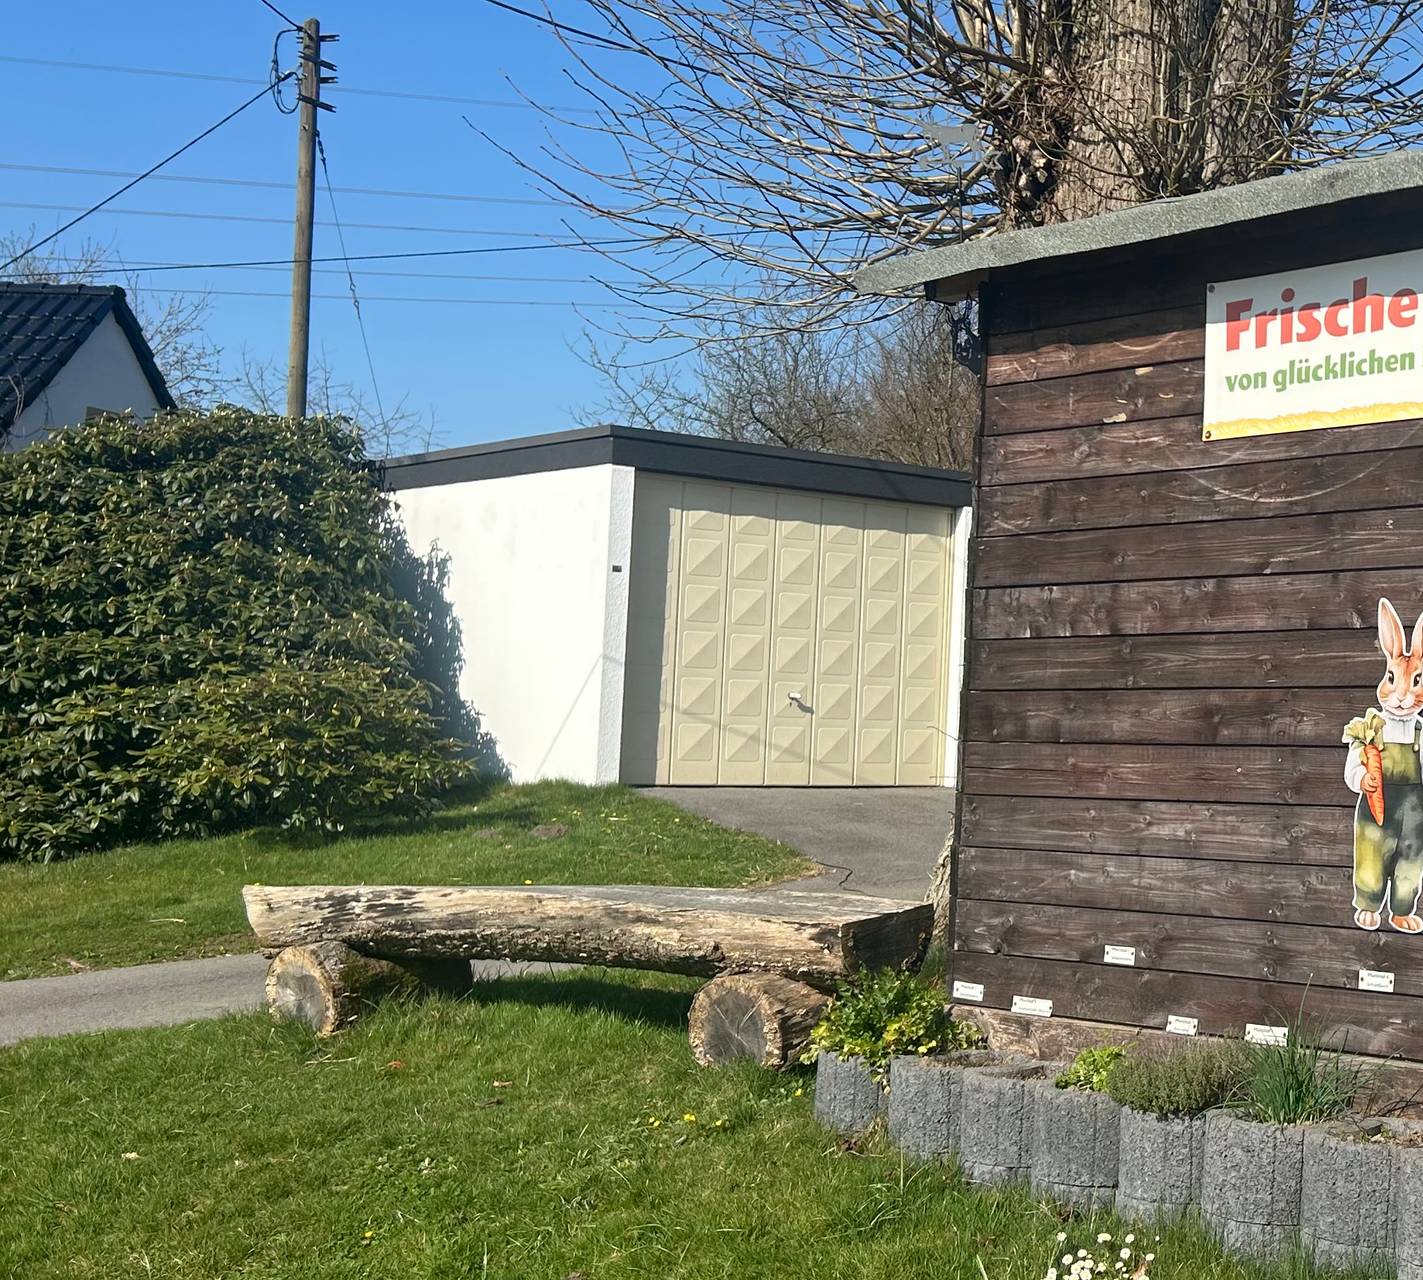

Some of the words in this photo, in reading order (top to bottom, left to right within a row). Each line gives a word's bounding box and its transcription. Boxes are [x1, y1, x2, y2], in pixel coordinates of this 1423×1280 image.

[1226, 277, 1418, 351] Frische
[1225, 371, 1267, 392] von
[1272, 349, 1415, 392] glücklichen
